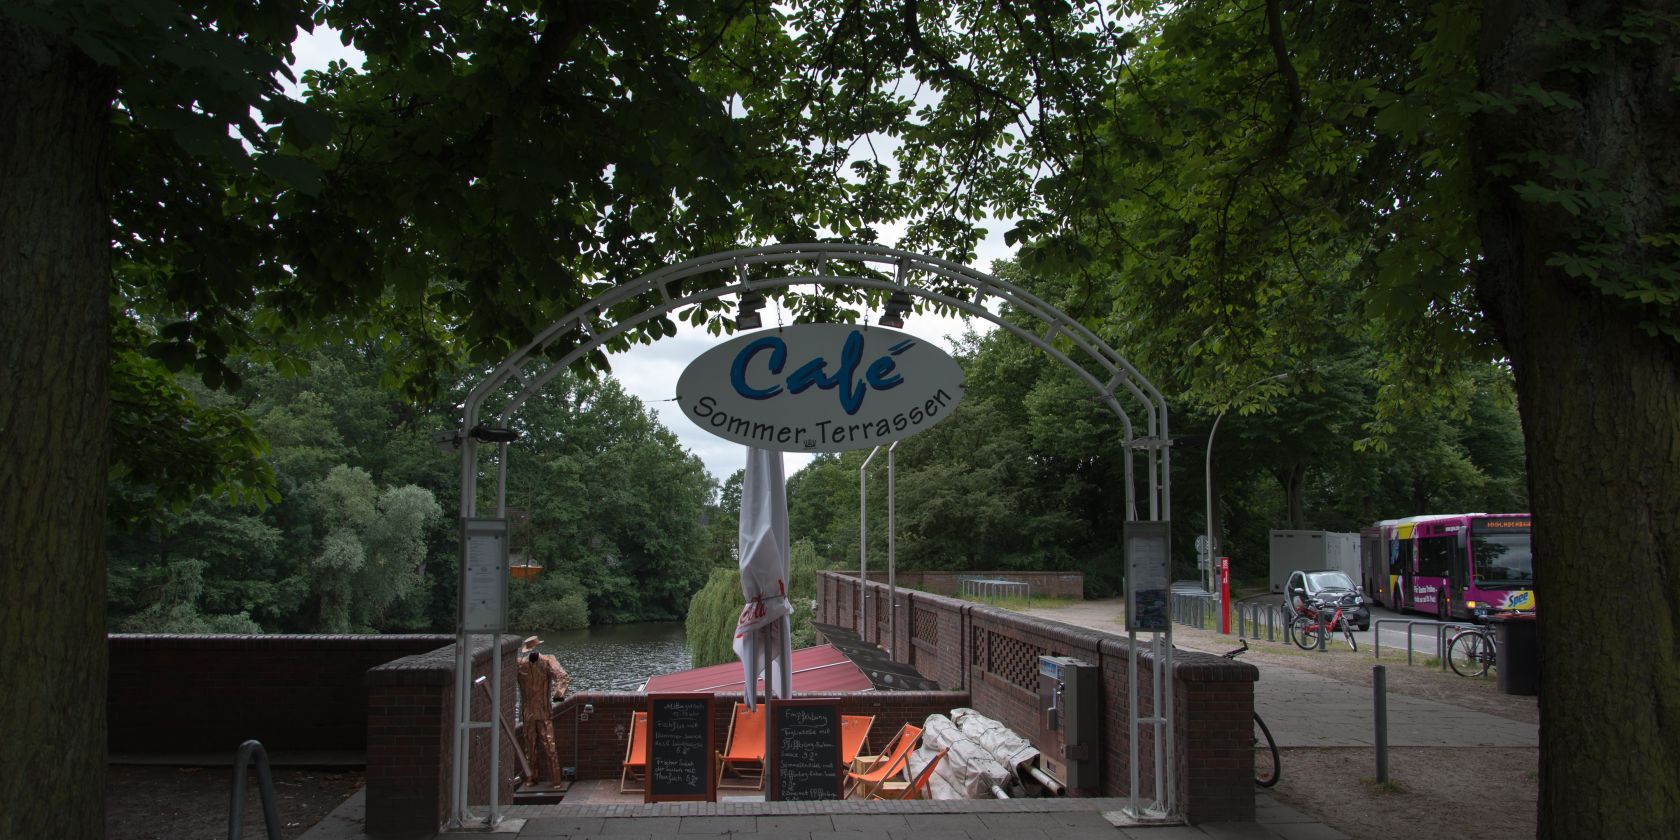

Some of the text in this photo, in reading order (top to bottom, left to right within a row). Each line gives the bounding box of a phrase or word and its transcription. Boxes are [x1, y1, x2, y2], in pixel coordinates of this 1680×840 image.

[730, 330, 916, 415] Café
[693, 388, 951, 444] Sommer Terrassen
[1508, 592, 1528, 608] Spee
